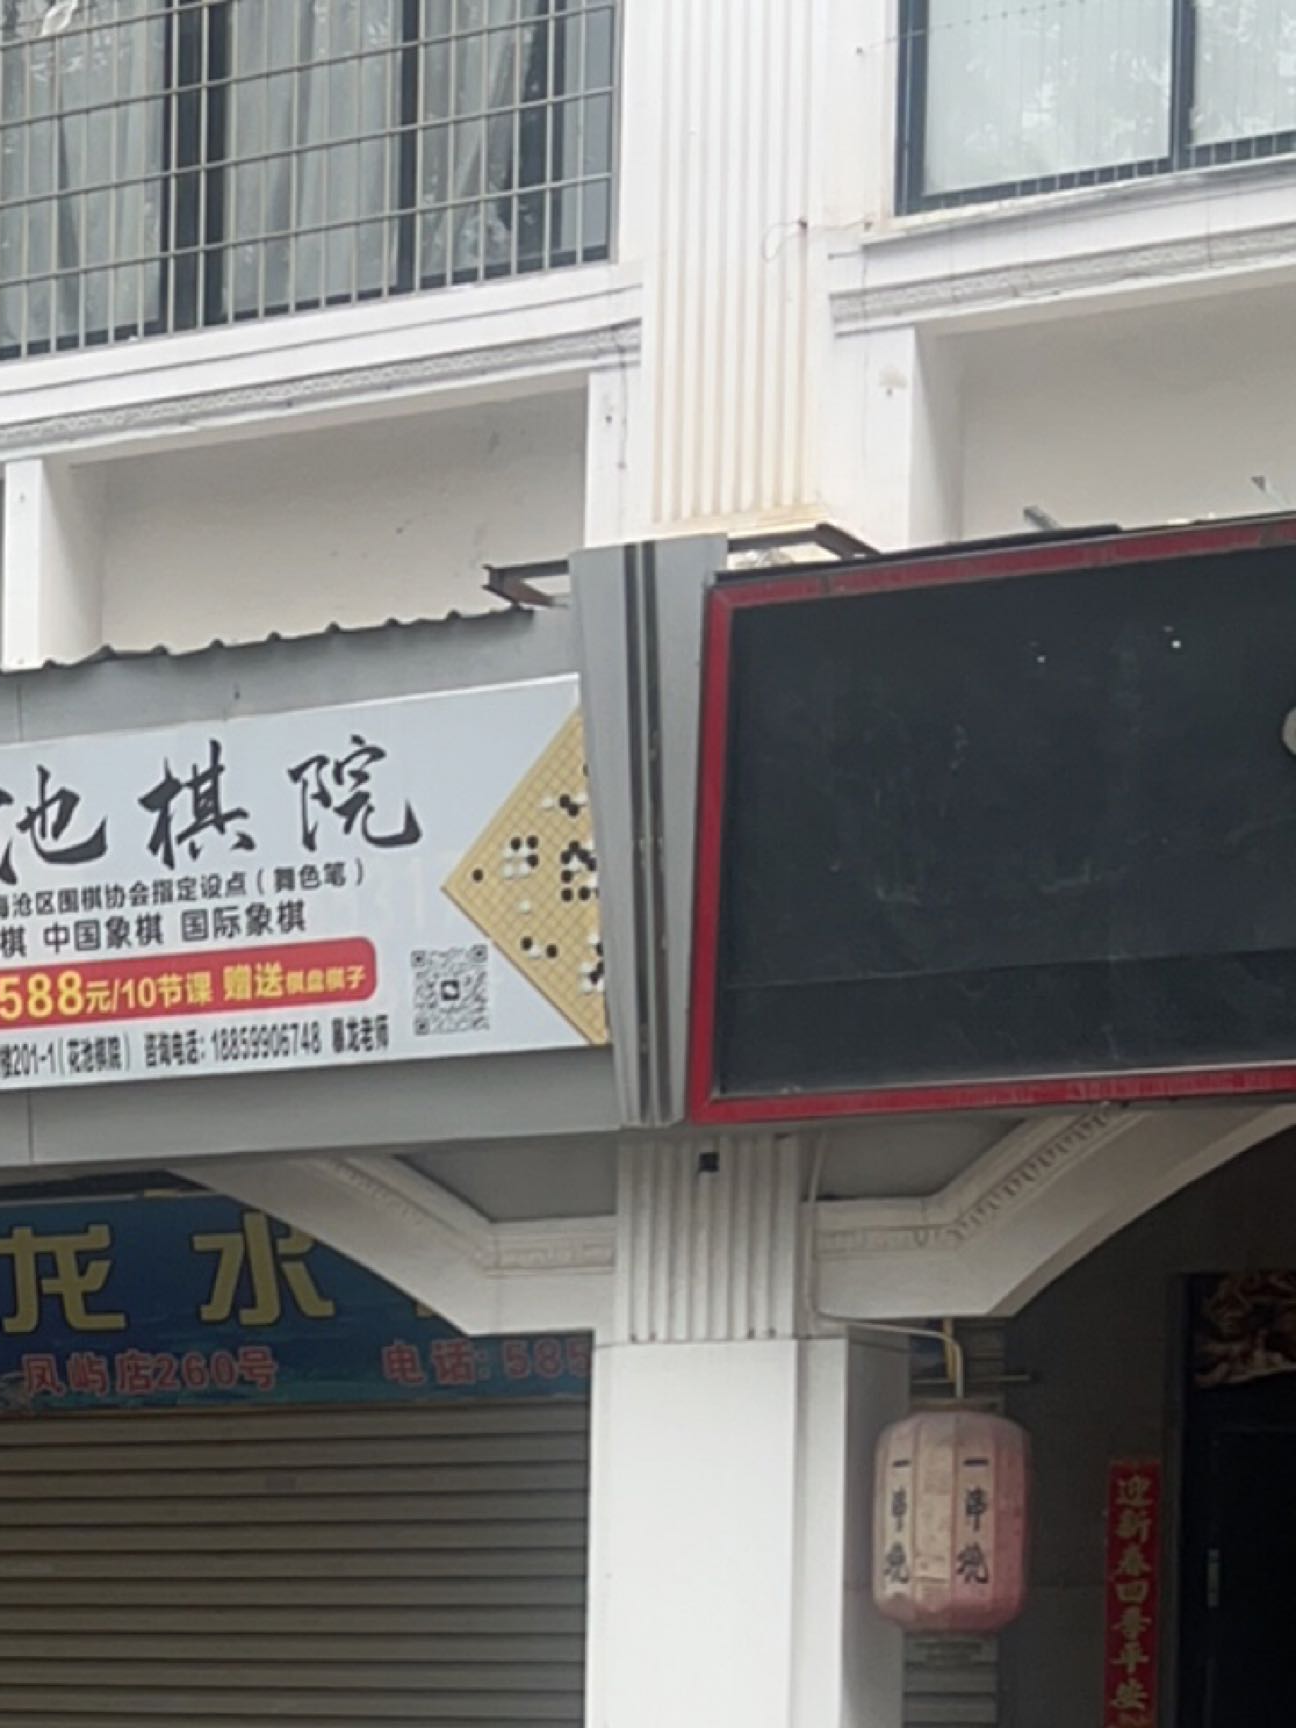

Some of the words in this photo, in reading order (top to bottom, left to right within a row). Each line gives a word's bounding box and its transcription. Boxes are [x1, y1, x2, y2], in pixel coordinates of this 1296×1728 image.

[44, 914, 164, 952] 中国象棋
[180, 900, 306, 942] 国际象棋
[1110, 1474, 1153, 1712] 迎新春四季平安
